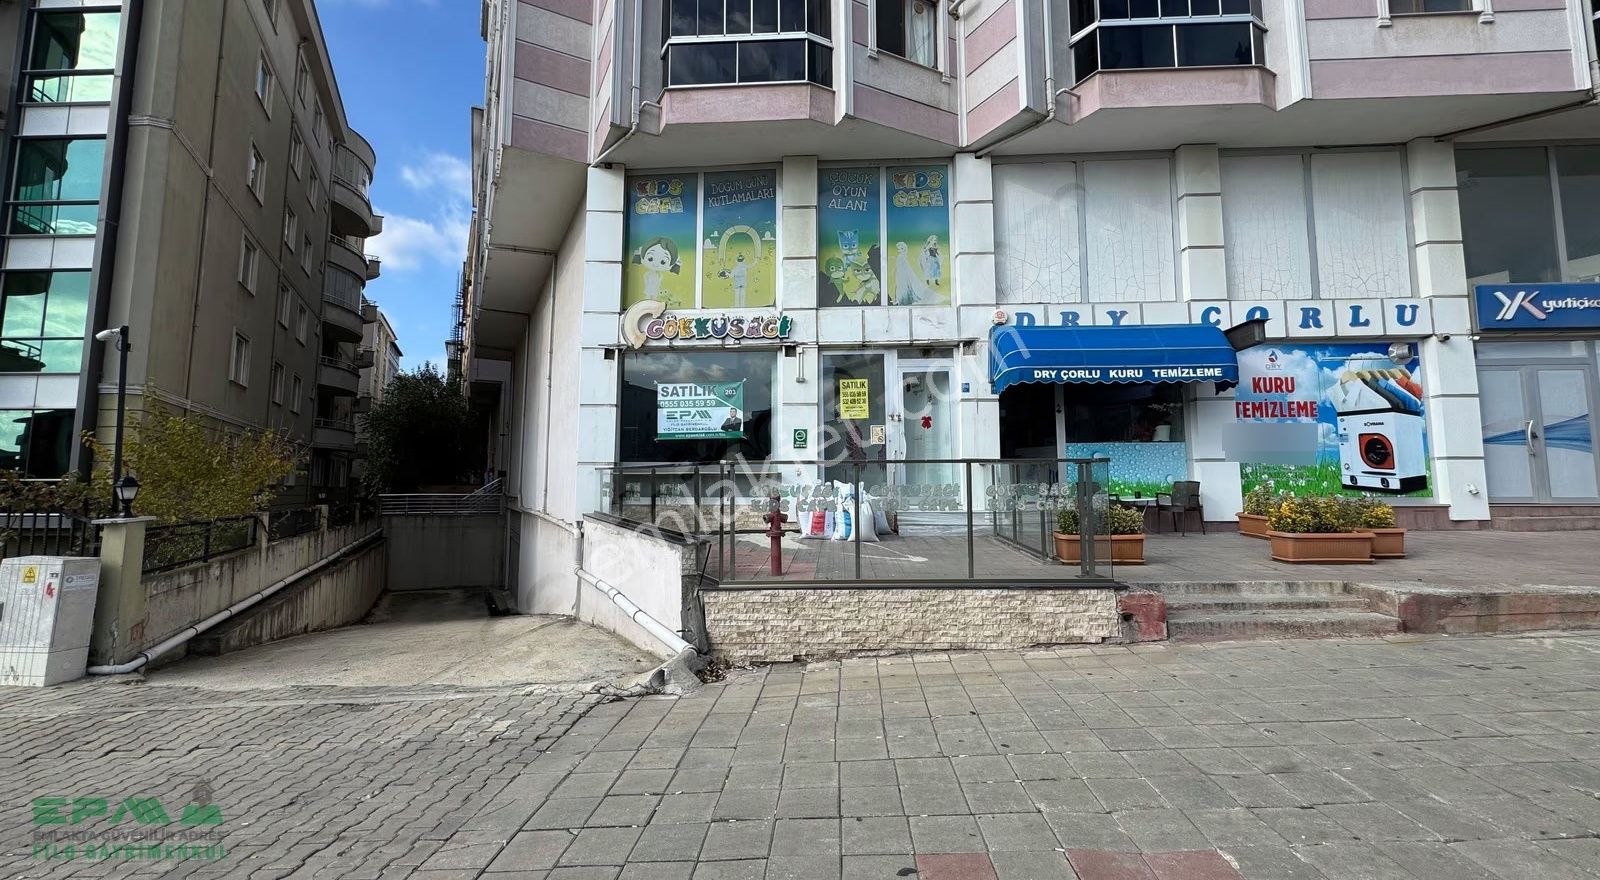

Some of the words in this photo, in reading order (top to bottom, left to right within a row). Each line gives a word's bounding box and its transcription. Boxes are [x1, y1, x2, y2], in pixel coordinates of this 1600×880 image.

[830, 170, 873, 186] ÇOCUK
[892, 171, 943, 189] KIDS
[636, 179, 684, 196] KIDS
[832, 185, 867, 198] OYUN
[635, 197, 684, 215] CAFE
[708, 188, 775, 208] KUTLAMALARI
[828, 198, 868, 212] ALANI
[892, 189, 944, 208] CAFE
[1015, 310, 1129, 327] DRY
[1034, 369, 1057, 379] DRY
[1060, 369, 1101, 380] ÇORLU
[1109, 369, 1143, 379] KURU
[1152, 367, 1222, 378] TEMİZLEME
[661, 385, 718, 397] SATILIK
[841, 381, 867, 390] SATILIK
[1252, 376, 1296, 394] KURU
[1236, 398, 1318, 419] TEMİZLEME
